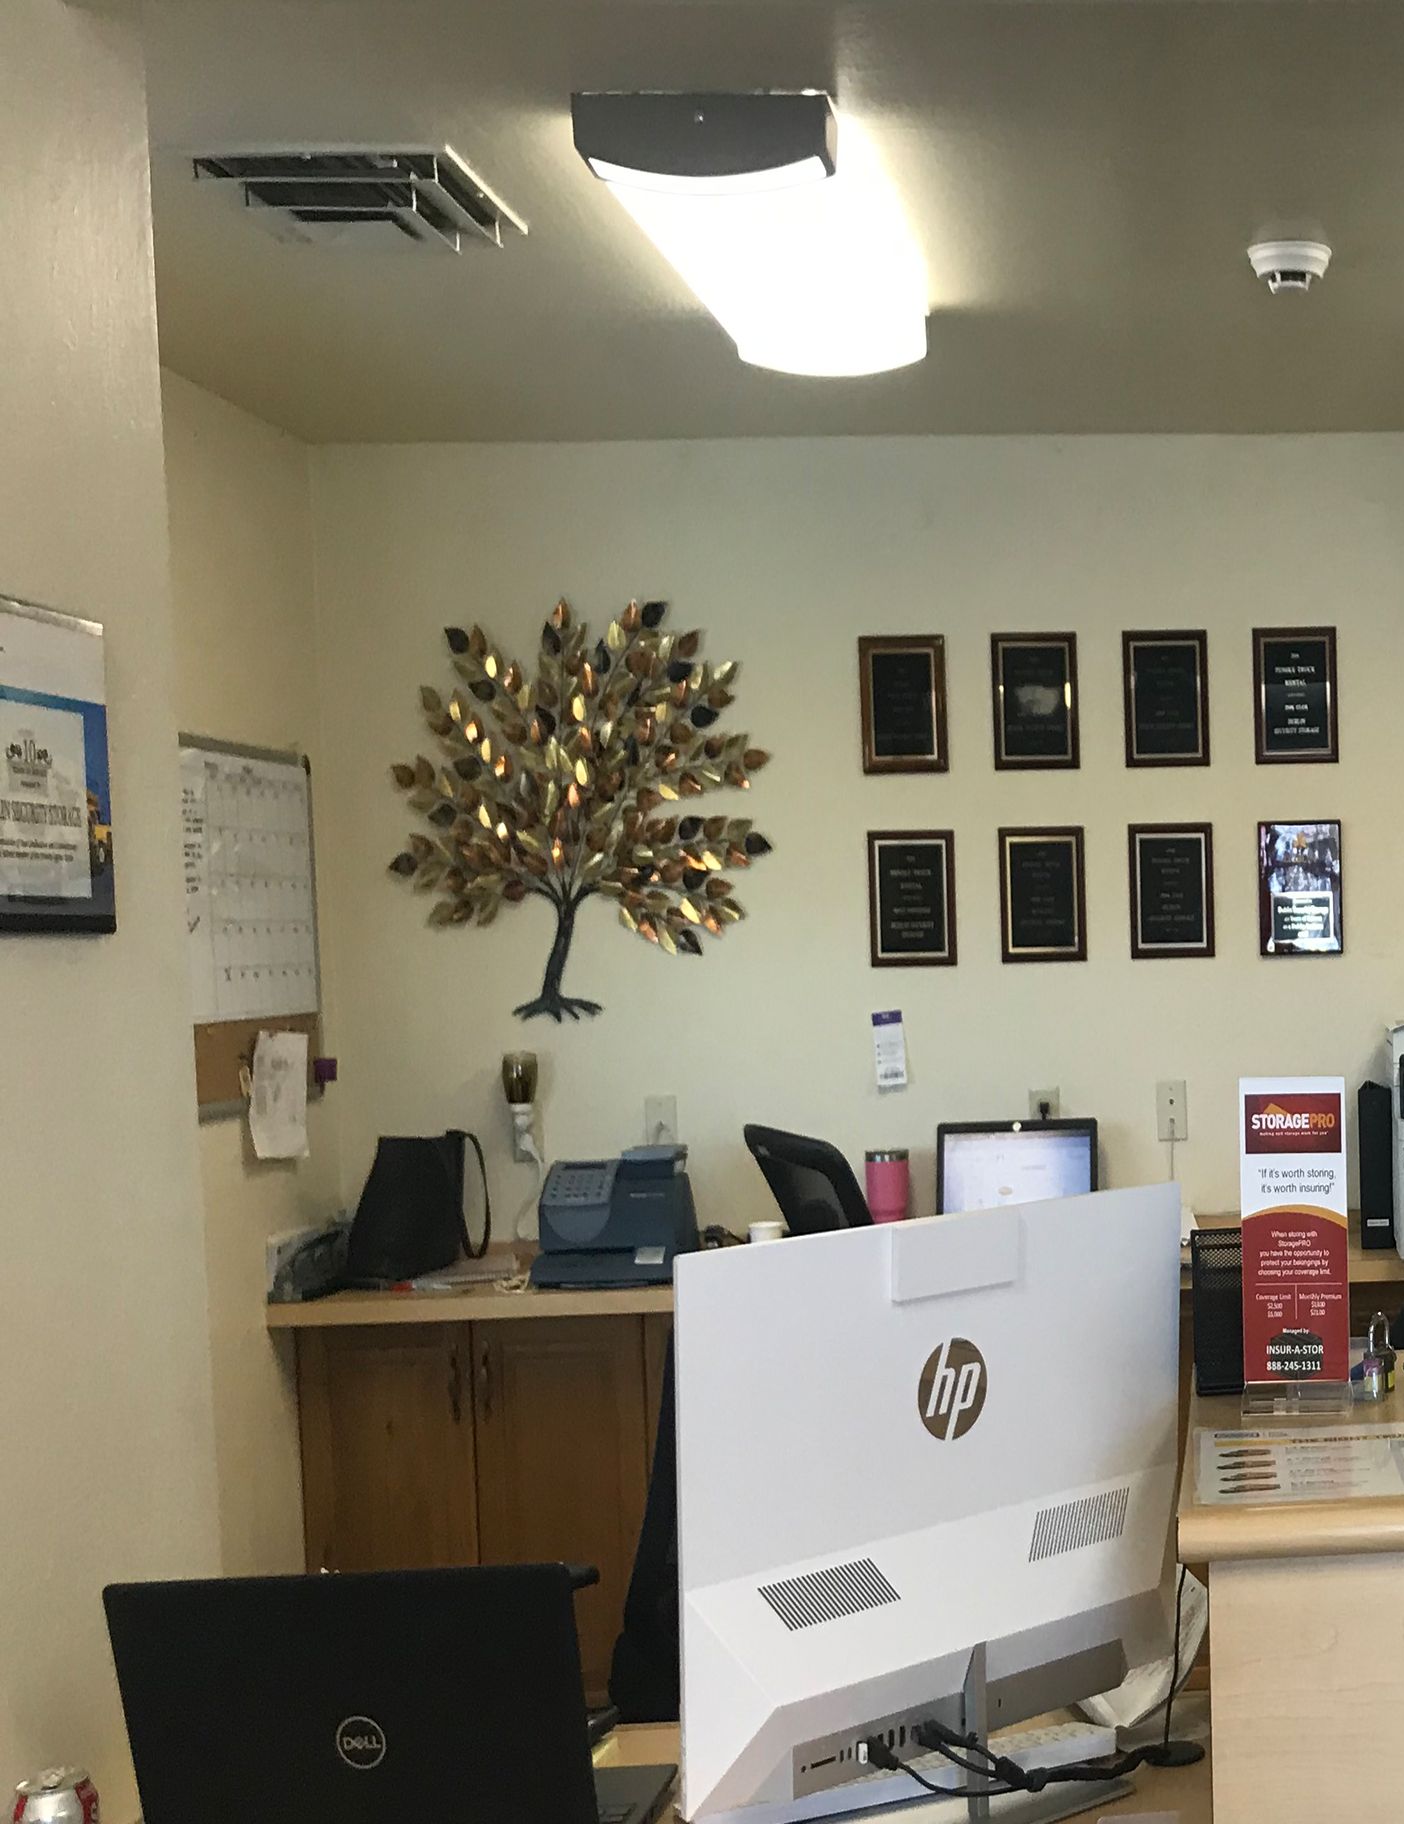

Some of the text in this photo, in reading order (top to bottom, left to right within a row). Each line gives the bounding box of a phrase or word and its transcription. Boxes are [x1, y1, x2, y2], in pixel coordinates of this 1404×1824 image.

[1251, 1113, 1335, 1129] STORAGEPRO
[1269, 1168, 1280, 1178] it's
[1282, 1168, 1305, 1178] worth
[1261, 1184, 1272, 1193] it's
[1274, 1183, 1297, 1193] worth
[1288, 1231, 1306, 1239] storing
[1307, 1230, 1318, 1238] with
[1277, 1240, 1312, 1248] StoragePRO
[1293, 1249, 1323, 1258] opportunity
[1260, 1259, 1329, 1268] protect your belongings by
[1258, 1269, 1281, 1277] choosing
[1282, 1269, 1294, 1277] your
[1294, 1269, 1319, 1277] coverage
[1255, 1293, 1279, 1301] Coverage
[1299, 1293, 1320, 1301] Monthly
[1266, 1345, 1324, 1355] INSUR-A-STOR
[1266, 1361, 1321, 1371] 888-245-1311
[921, 1337, 985, 1441] hp
[343, 1735, 381, 1750] DELL
